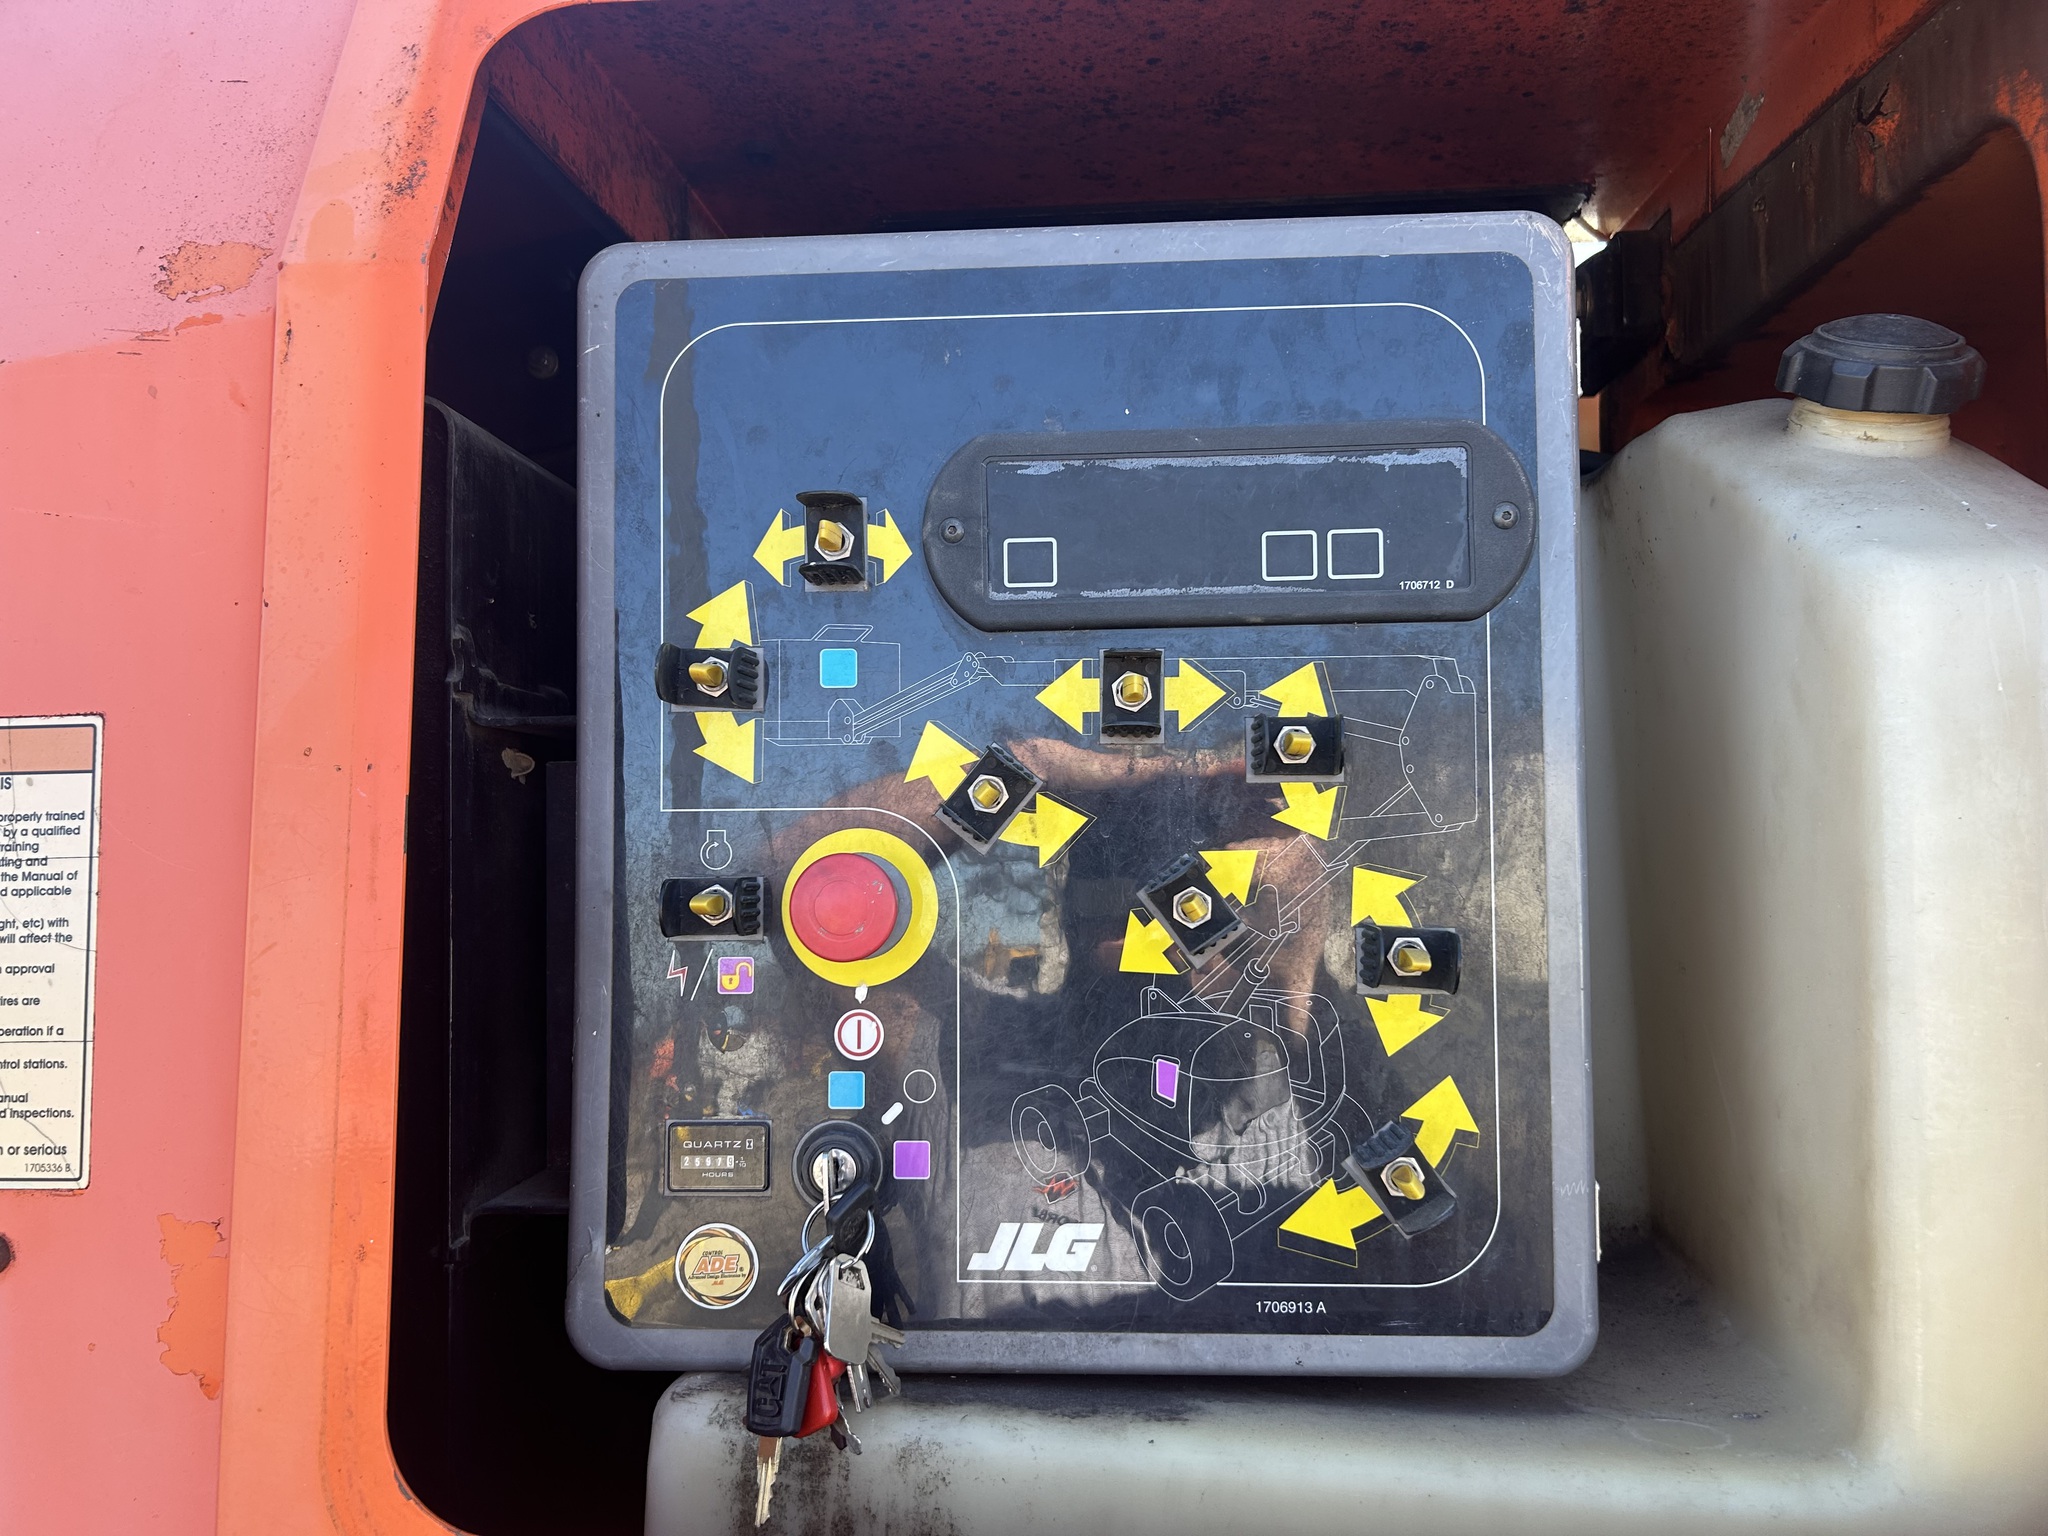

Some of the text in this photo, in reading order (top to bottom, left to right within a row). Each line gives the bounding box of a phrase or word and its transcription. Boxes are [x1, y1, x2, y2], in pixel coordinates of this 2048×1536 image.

[1399, 580, 1455, 590] 1706712 D
[45, 811, 85, 820] trained
[3, 826, 81, 839] by a qualified
[25, 856, 48, 866] and
[1, 870, 78, 881] the Manual of
[11, 885, 72, 898] applicable
[22, 918, 44, 930] etc)
[47, 917, 69, 927] with
[19, 933, 52, 943] affect
[54, 933, 73, 942] the
[5, 963, 55, 976] approval
[21, 997, 41, 1005] are
[47, 1026, 54, 1036] if
[23, 1058, 68, 1069] stations.
[9, 1108, 74, 1121] inspections.
[7, 1146, 20, 1155] or
[23, 1143, 67, 1156] serious
[683, 1141, 741, 1149] QUARTZ
[25, 1163, 63, 1173] 1705336
[1256, 1301, 1327, 1314] 1706913 A
[756, 1363, 788, 1418] CAT
